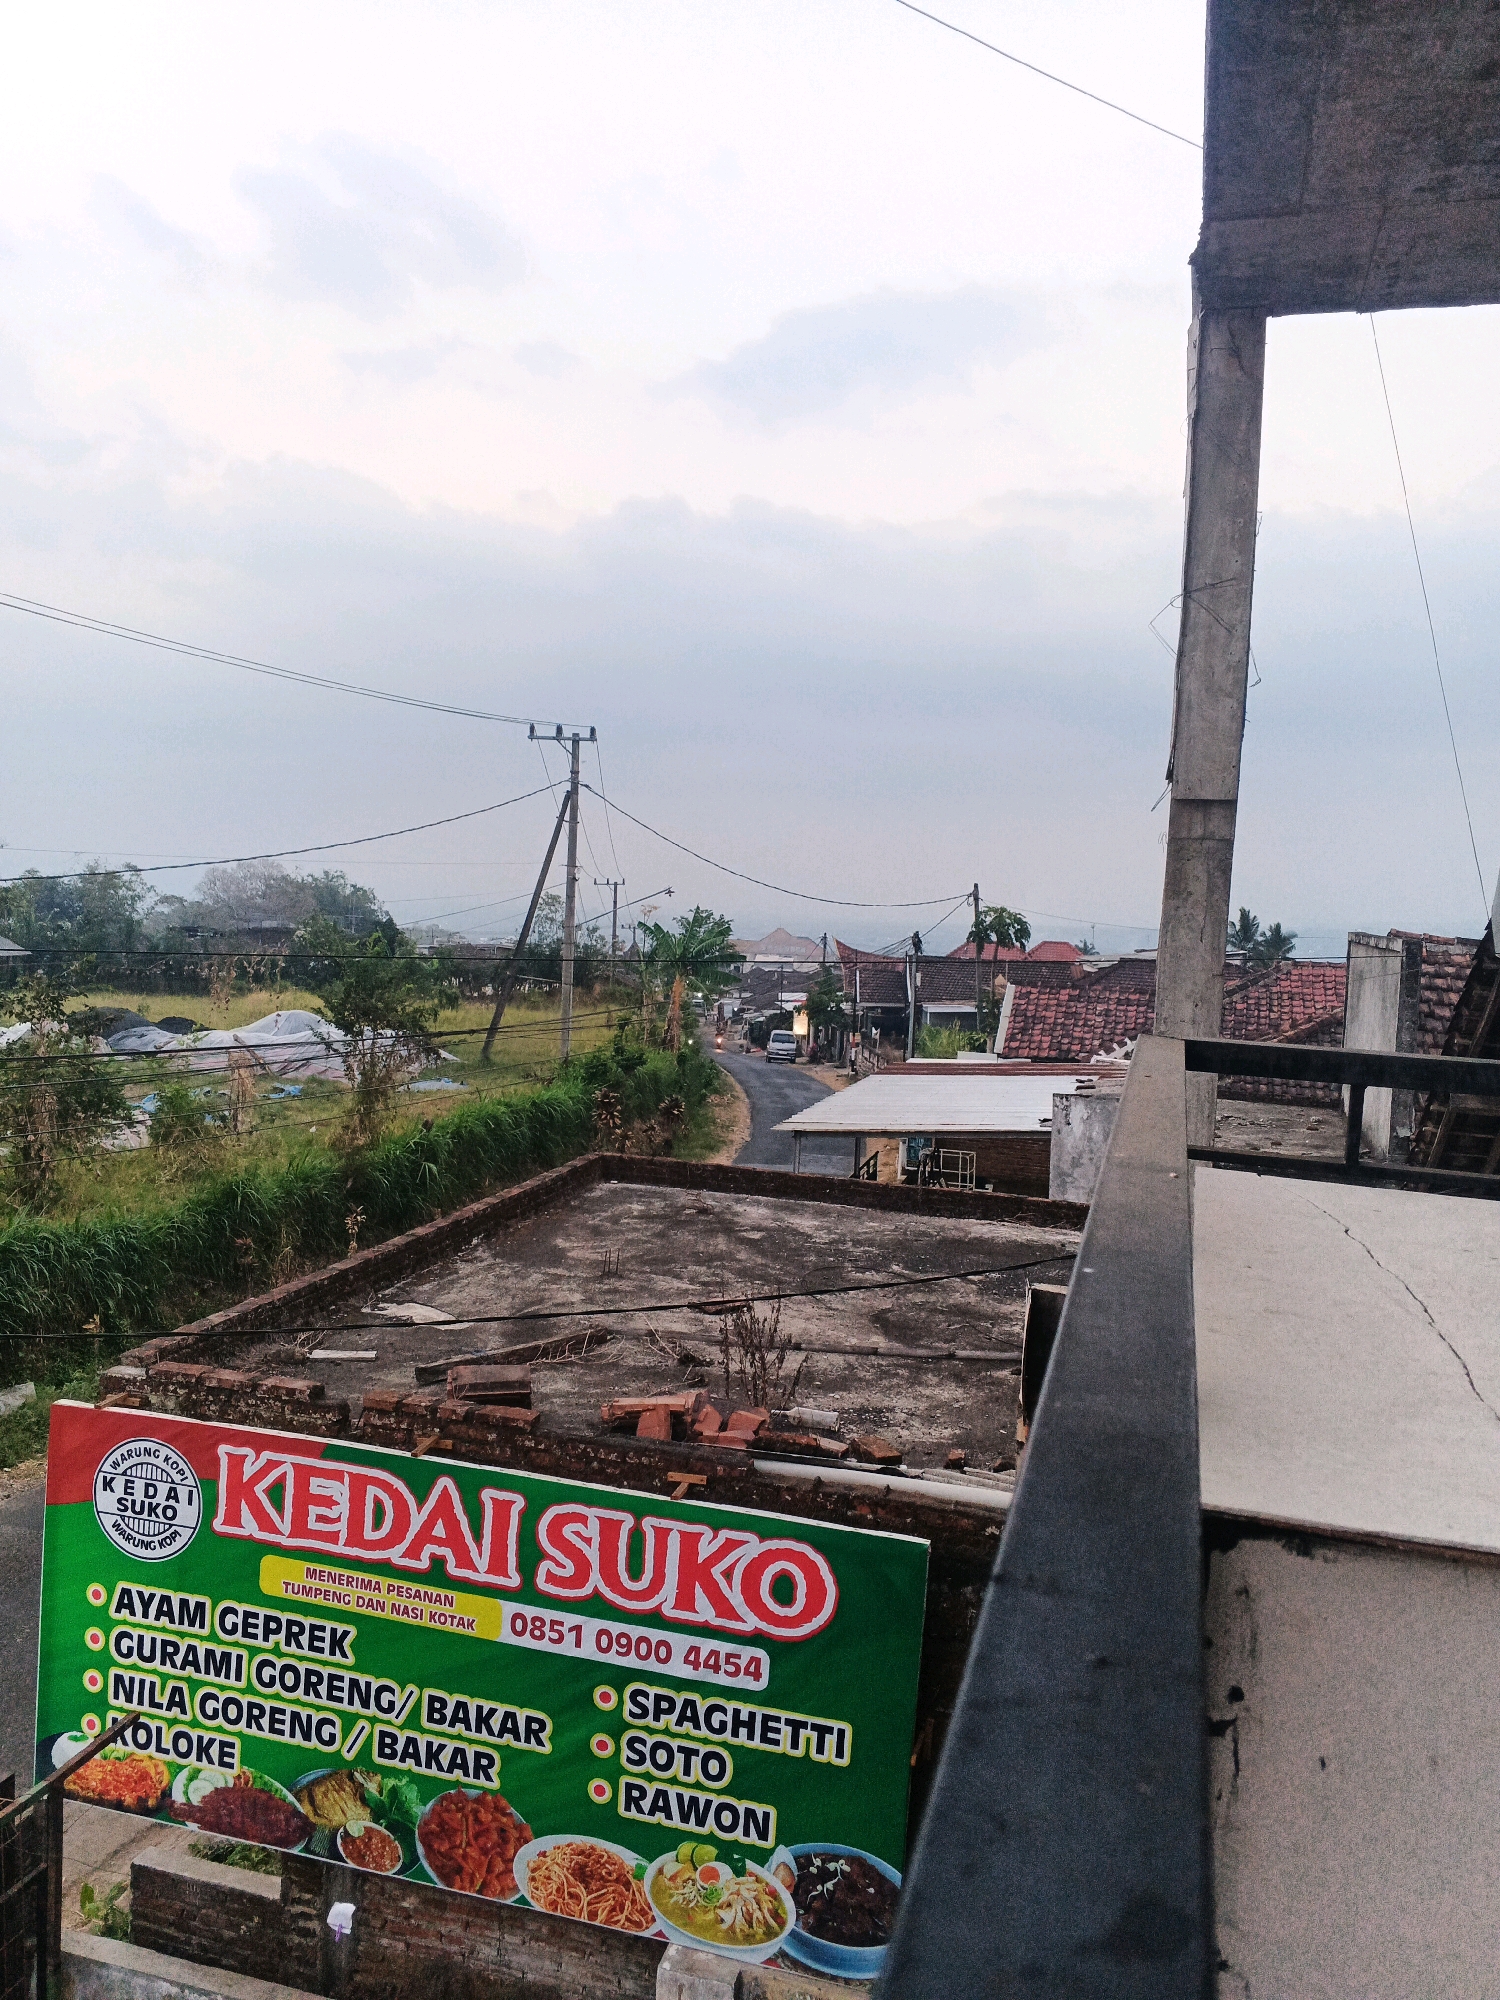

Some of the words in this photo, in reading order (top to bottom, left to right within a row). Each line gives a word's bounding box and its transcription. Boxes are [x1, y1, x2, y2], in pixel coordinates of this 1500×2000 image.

[102, 1475, 194, 1507] KEDAI
[110, 1446, 160, 1470] WARUNG
[163, 1453, 188, 1482] KOPI
[111, 1519, 157, 1551] WARUNG
[158, 1529, 182, 1550] KOPI
[116, 1496, 178, 1521] SUKO
[214, 1445, 523, 1588] KEDAI
[537, 1504, 836, 1637] SUKO
[282, 1581, 352, 1606] TUMPENG
[355, 1595, 386, 1613] DAN
[390, 1602, 424, 1621] NASI
[428, 1610, 476, 1632] KOTAK
[305, 1566, 382, 1593] MENERIMA
[386, 1583, 455, 1608] PESANAN
[113, 1586, 208, 1631] AYAM
[218, 1605, 354, 1661] GEPREK
[510, 1611, 584, 1649] 0851
[595, 1628, 673, 1665] 0900
[683, 1645, 763, 1682] 4454
[113, 1630, 244, 1683] GURAMI
[425, 1693, 548, 1748] BAKAR
[112, 1673, 188, 1716] NILA
[199, 1690, 338, 1747] GORENG
[376, 1729, 497, 1783] BAKAR
[627, 1688, 847, 1760] SPAGHETTI
[624, 1735, 728, 1783] SOTO
[623, 1781, 772, 1843] RAWON
